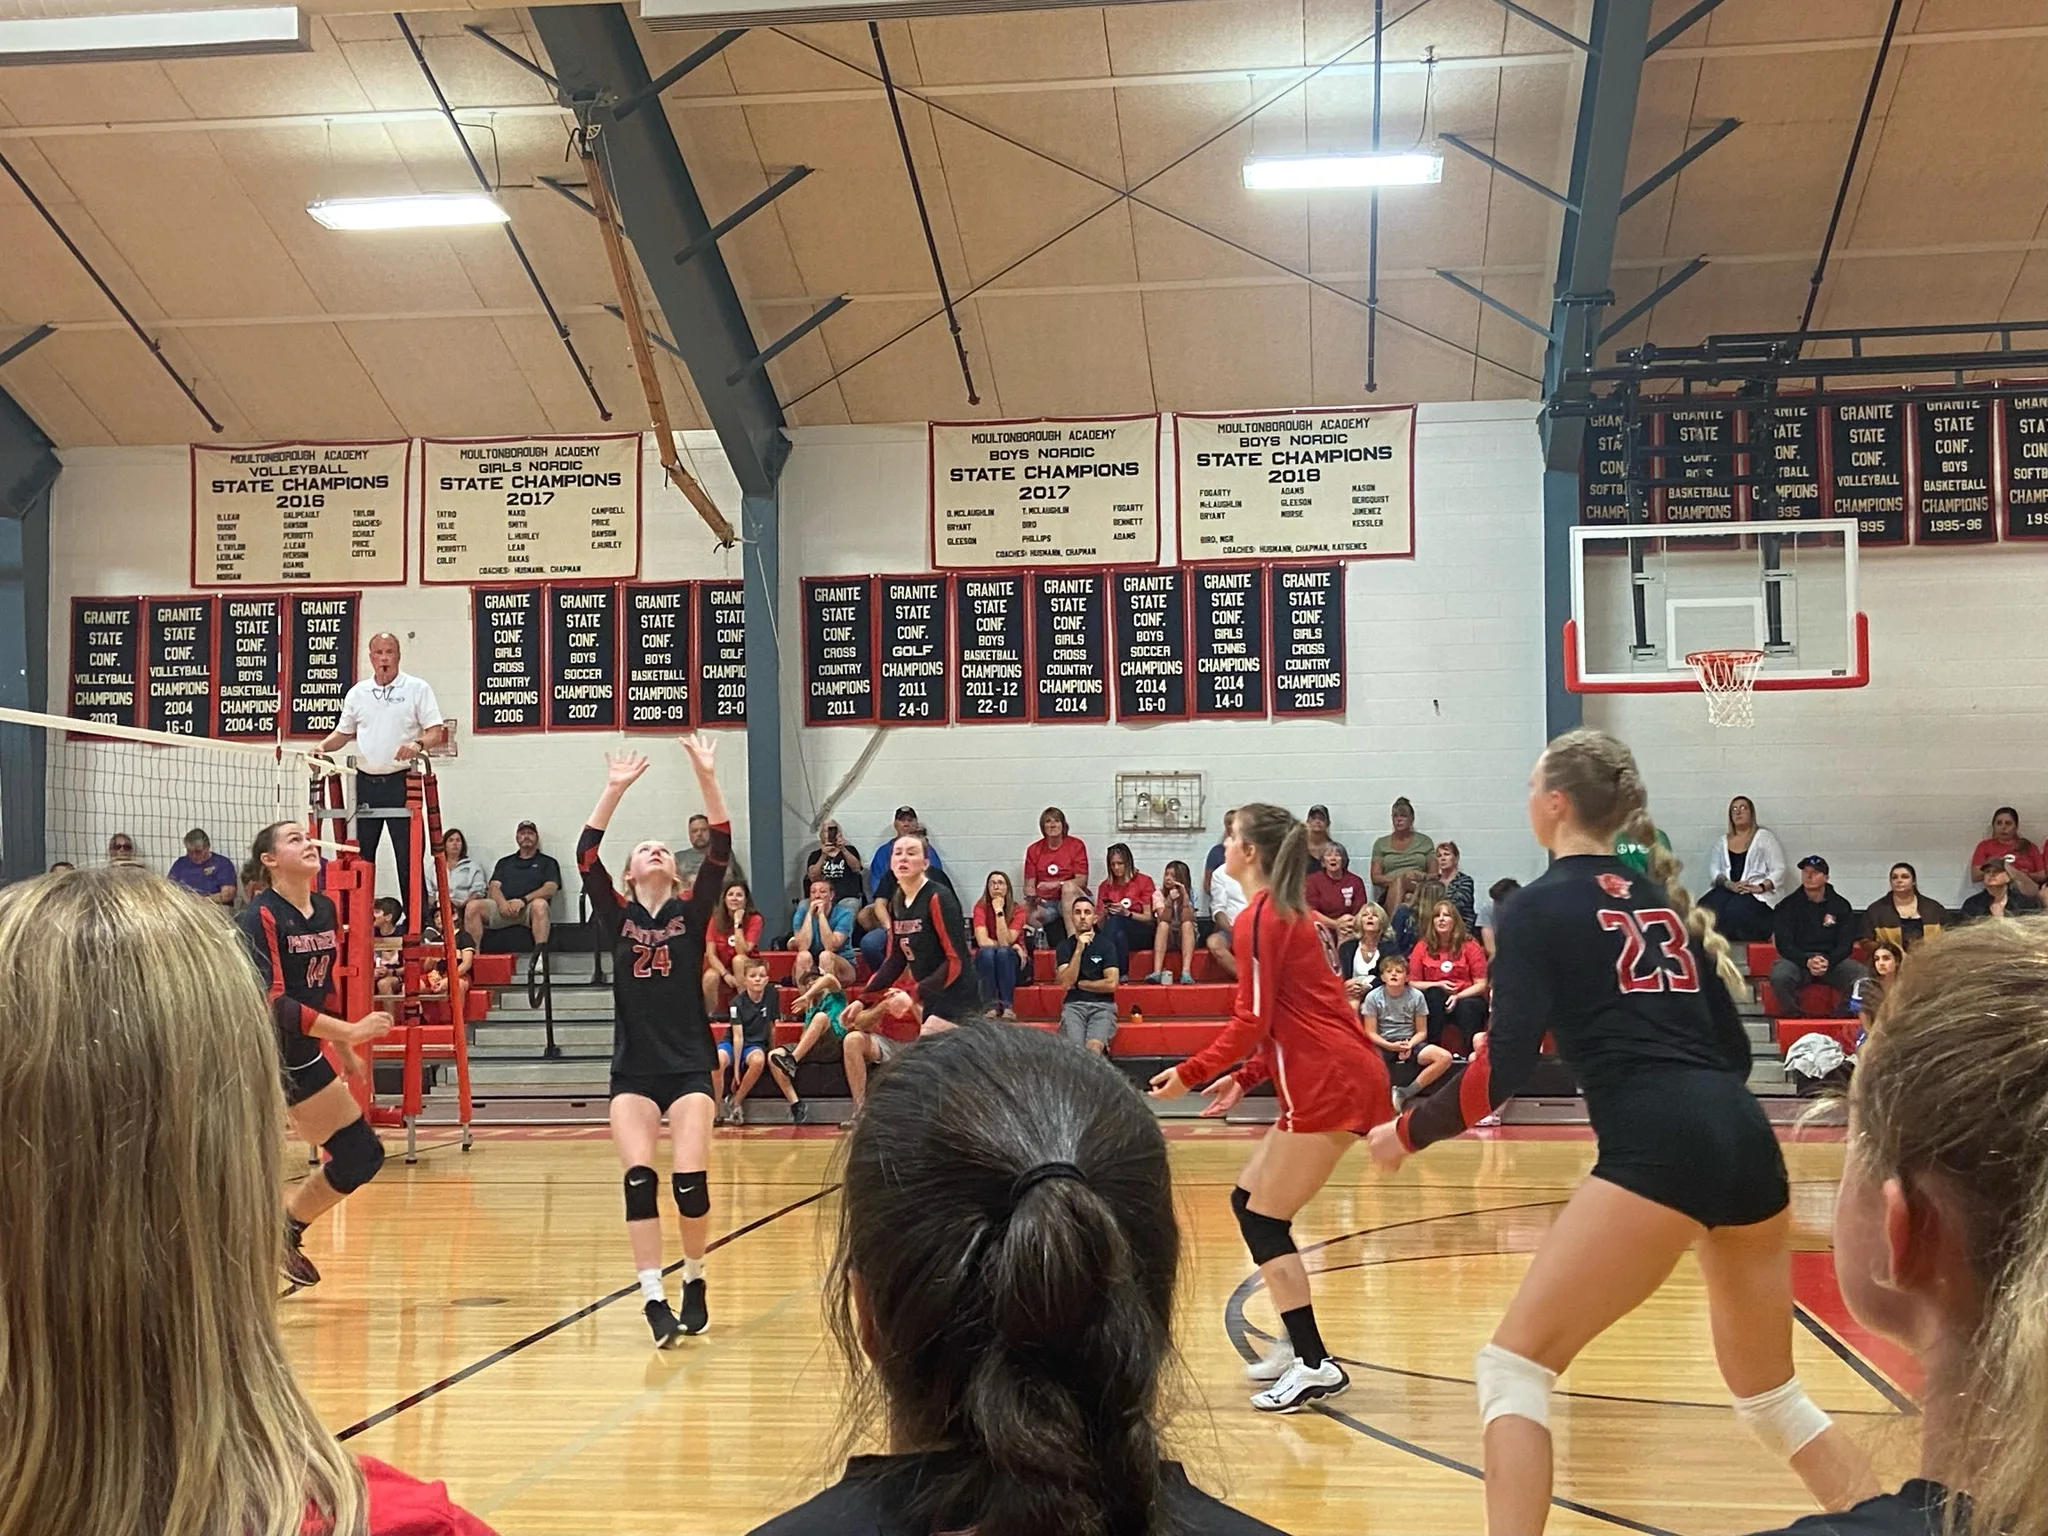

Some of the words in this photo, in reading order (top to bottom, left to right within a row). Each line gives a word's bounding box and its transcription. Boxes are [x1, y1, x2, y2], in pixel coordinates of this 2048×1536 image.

[1840, 404, 1894, 421] GRANITE
[1218, 420, 1313, 434] MOULTONBOROUGH
[1320, 418, 1371, 430] ACADEMY
[1934, 416, 1975, 432] STATE
[971, 431, 1061, 444] MOULTONBOROUGH
[1068, 429, 1116, 441] ACADEMY
[1239, 436, 1280, 448] BOYS
[1289, 433, 1348, 445] NORDIC
[1849, 428, 1886, 444] STATE
[460, 447, 548, 460] MOULTONBOROUGH
[554, 446, 600, 457] ACADEMY
[1935, 438, 1974, 454] CONF.
[230, 450, 315, 464] MOULTONBOROUGH
[324, 449, 369, 461] ACADEMY
[989, 450, 1029, 461] BOYS
[1038, 447, 1095, 458] NORDIC
[1196, 452, 1262, 467] STATE
[1271, 446, 1392, 465] CHAMPIONS
[1851, 451, 1886, 467] CONF.
[249, 464, 348, 477] VOLLEYBALL
[479, 462, 521, 474] GIRLS
[529, 460, 583, 471] NORDIC
[950, 467, 1016, 482] STATE
[1024, 462, 1139, 479] CHAMPIONS
[1941, 461, 1968, 473] BOYS
[440, 476, 503, 490] STATE
[512, 472, 622, 488] CHAMPIONS
[1268, 468, 1321, 483] 2018
[211, 479, 274, 493] STATE
[282, 475, 389, 491] CHAMPIONS
[1280, 487, 1305, 495] ADAMS
[1352, 484, 1376, 492] MASON
[1923, 478, 1987, 492] BASKETBALL
[506, 492, 555, 506] 2017
[1018, 485, 1071, 500] 2017
[1199, 489, 1232, 497] FOGARTY
[276, 494, 325, 508] 2016
[1113, 504, 1144, 512] FOGARTY
[1280, 498, 1312, 507] GLEESON
[1834, 496, 1903, 513] CHAMPIONS
[1921, 496, 1989, 513] CHAMPIONS
[352, 509, 375, 517] TAYLOR
[1199, 512, 1226, 520] BRYANT
[1352, 507, 1382, 516] JIMENEZ
[1667, 505, 1732, 521] CHAMPIONS
[946, 523, 971, 531] BRYANT
[1352, 519, 1384, 527] KESSLER
[947, 537, 977, 546] GLEESON
[1021, 534, 1051, 543] PHILLIPS
[1113, 532, 1136, 540] ADAMS
[352, 540, 370, 548] PRICE
[1066, 548, 1096, 556] CHAPMAN
[216, 563, 234, 571] PRICE
[1123, 575, 1174, 592] GRANITE
[1204, 573, 1252, 589] GRANITE
[1282, 572, 1331, 589] GRANITE
[814, 586, 861, 602] GRANITE
[890, 584, 938, 600] GRANITE
[966, 581, 1014, 597] GRANITE
[484, 593, 531, 609] GRANITE
[560, 594, 607, 609] GRANITE
[635, 594, 681, 609] GRANITE
[974, 599, 1008, 614] STATE
[1050, 597, 1087, 612] STATE
[1211, 592, 1245, 607] STATE
[1288, 591, 1326, 607] STATE
[157, 607, 203, 622] GRANITE
[301, 601, 347, 615] GRANITE
[821, 606, 856, 622] STATE
[895, 605, 931, 620] STATE
[83, 610, 130, 625] GRANITE
[491, 612, 526, 627] STATE
[566, 613, 601, 628] STATE
[640, 614, 675, 629] STATE
[1053, 615, 1086, 630] CONF.
[1133, 612, 1166, 627] CONF.
[1212, 610, 1245, 625] CONF.
[1291, 610, 1324, 625] CONF.
[163, 626, 197, 641] STATE
[235, 620, 269, 635] STATE
[307, 619, 341, 633] STATE
[897, 625, 929, 640] CONF.
[88, 631, 123, 646] STATE
[568, 633, 600, 648] CONF.
[641, 633, 674, 648] CONF.
[823, 626, 855, 642] CONF.
[978, 635, 1005, 647] BOYS
[1054, 634, 1085, 645] GIRLS
[1136, 630, 1164, 642] BOYS
[1214, 628, 1243, 640] GIRLS
[1293, 628, 1322, 640] GIRLS
[236, 638, 267, 652] CONF.
[308, 636, 339, 651] CONF.
[892, 644, 934, 657] GOLF
[1211, 643, 1246, 655] TENNIS
[1291, 643, 1325, 655] CROSS
[164, 645, 195, 661] CONF.
[495, 647, 522, 659] GIRLS
[570, 652, 596, 664] BOYS
[644, 653, 672, 665] BOYS
[720, 648, 744, 659] GOLF
[823, 647, 857, 659] CROSS
[964, 649, 1018, 661] BASKETBALL
[1053, 649, 1087, 661] CROSS
[1130, 645, 1171, 658] SOCCER
[89, 652, 121, 667] CONF.
[309, 654, 336, 665] GIRLS
[1198, 657, 1260, 673] CHAMPIONS
[1285, 658, 1331, 671] COUNTRY
[150, 665, 210, 678] VOLLEYBALL
[307, 668, 338, 680] CROSS
[493, 662, 525, 674] CROSS
[631, 669, 685, 681] BASKETBALL
[818, 663, 862, 676] COUNTRY
[961, 663, 1022, 679] CHAMPIONS
[1120, 660, 1183, 677] CHAMPIONS
[74, 673, 135, 685] VOLLEYBALL
[486, 676, 531, 688] COUNTRY
[1039, 679, 1103, 694] CHAMPIONS
[1135, 679, 1167, 694] 2014
[1214, 675, 1244, 691] 2014
[1277, 673, 1341, 690] CHAMPIONS
[150, 681, 209, 697] CHAMPIONS
[300, 683, 343, 694] COUNTRY
[554, 684, 613, 700] CHAMPIONS
[628, 685, 688, 701] CHAMPIONS
[811, 679, 870, 696] CHAMPIONS
[898, 682, 927, 697] 2011
[75, 691, 134, 706] CHAMPIONS
[1055, 697, 1088, 712] 2014
[1294, 693, 1325, 708] 2015
[164, 700, 193, 716] 2004
[494, 708, 524, 723] 2006
[568, 704, 598, 719] 2007
[827, 700, 856, 716] 2011
[307, 715, 336, 730] 2005
[1596, 908, 1700, 994] 23
[632, 944, 672, 978] 24
[306, 954, 330, 988] 14
